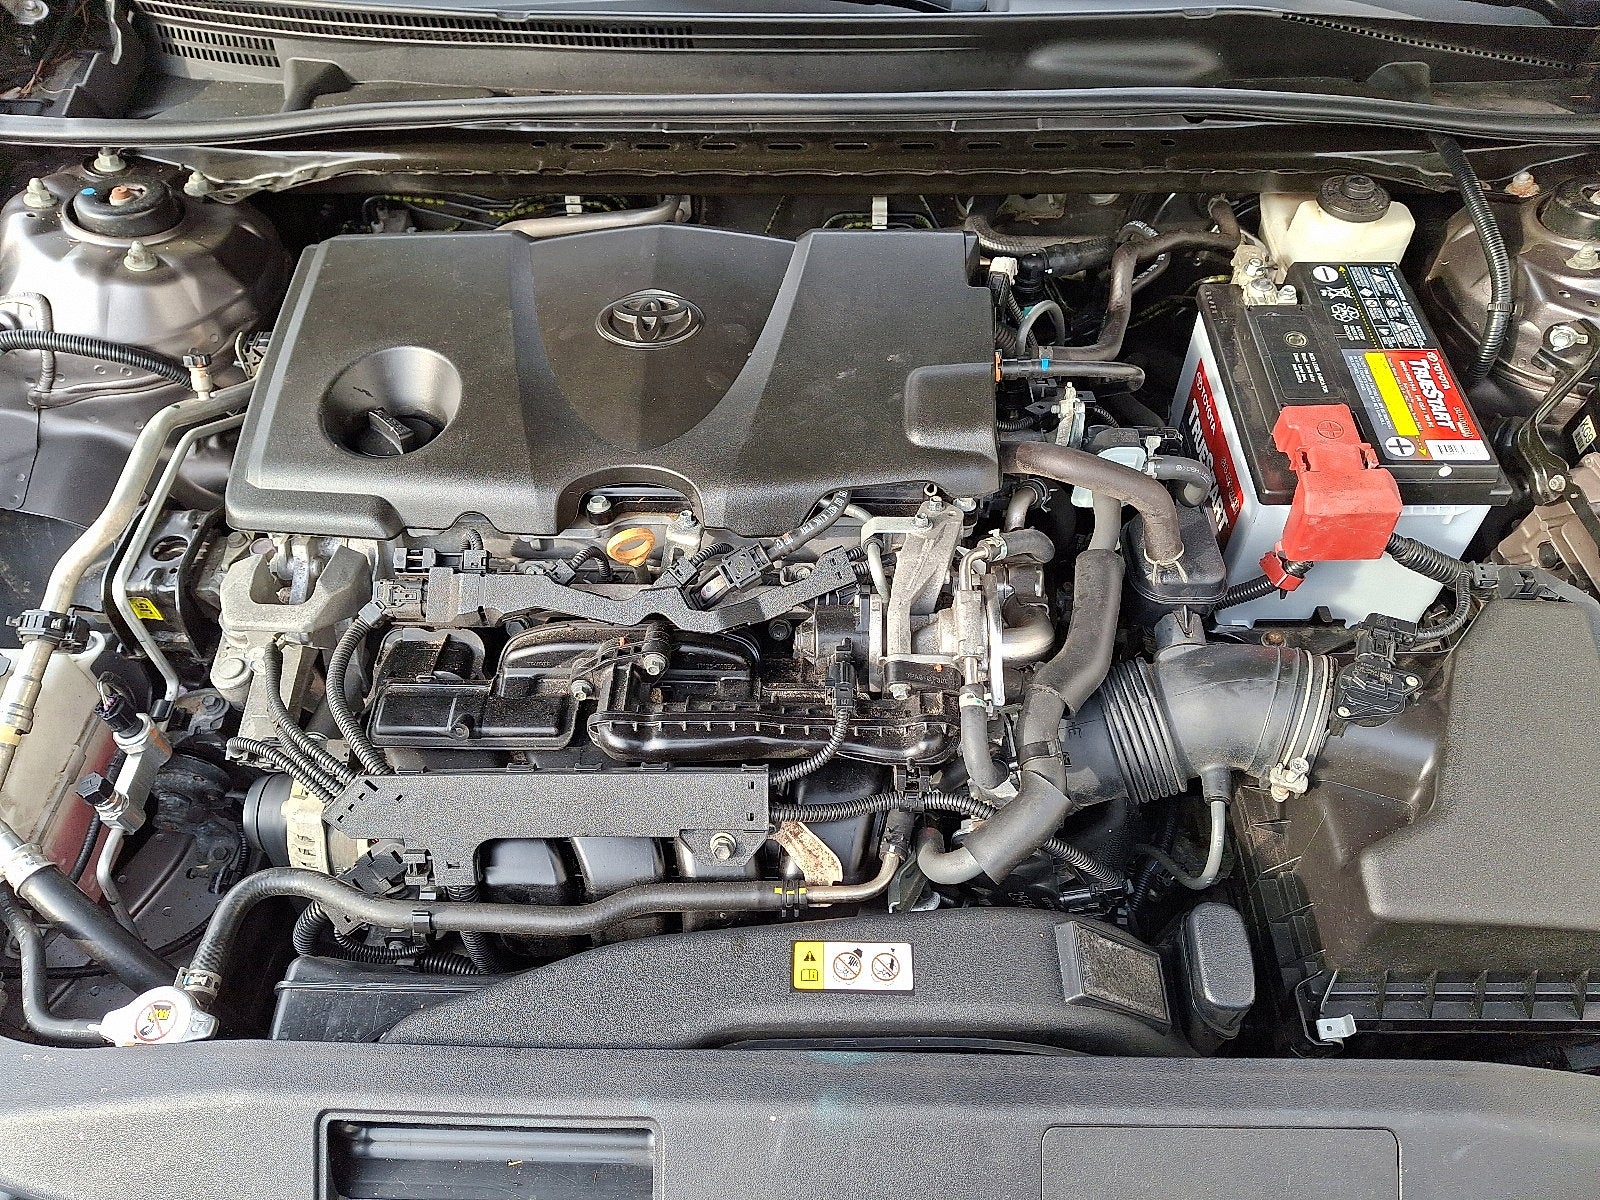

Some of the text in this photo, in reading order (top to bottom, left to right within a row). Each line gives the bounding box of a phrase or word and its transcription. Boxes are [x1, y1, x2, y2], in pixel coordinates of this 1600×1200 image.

[1431, 361, 1452, 390] TOYOTA
[1200, 390, 1216, 435] TOYOTA
[1580, 419, 1594, 444] KG9
